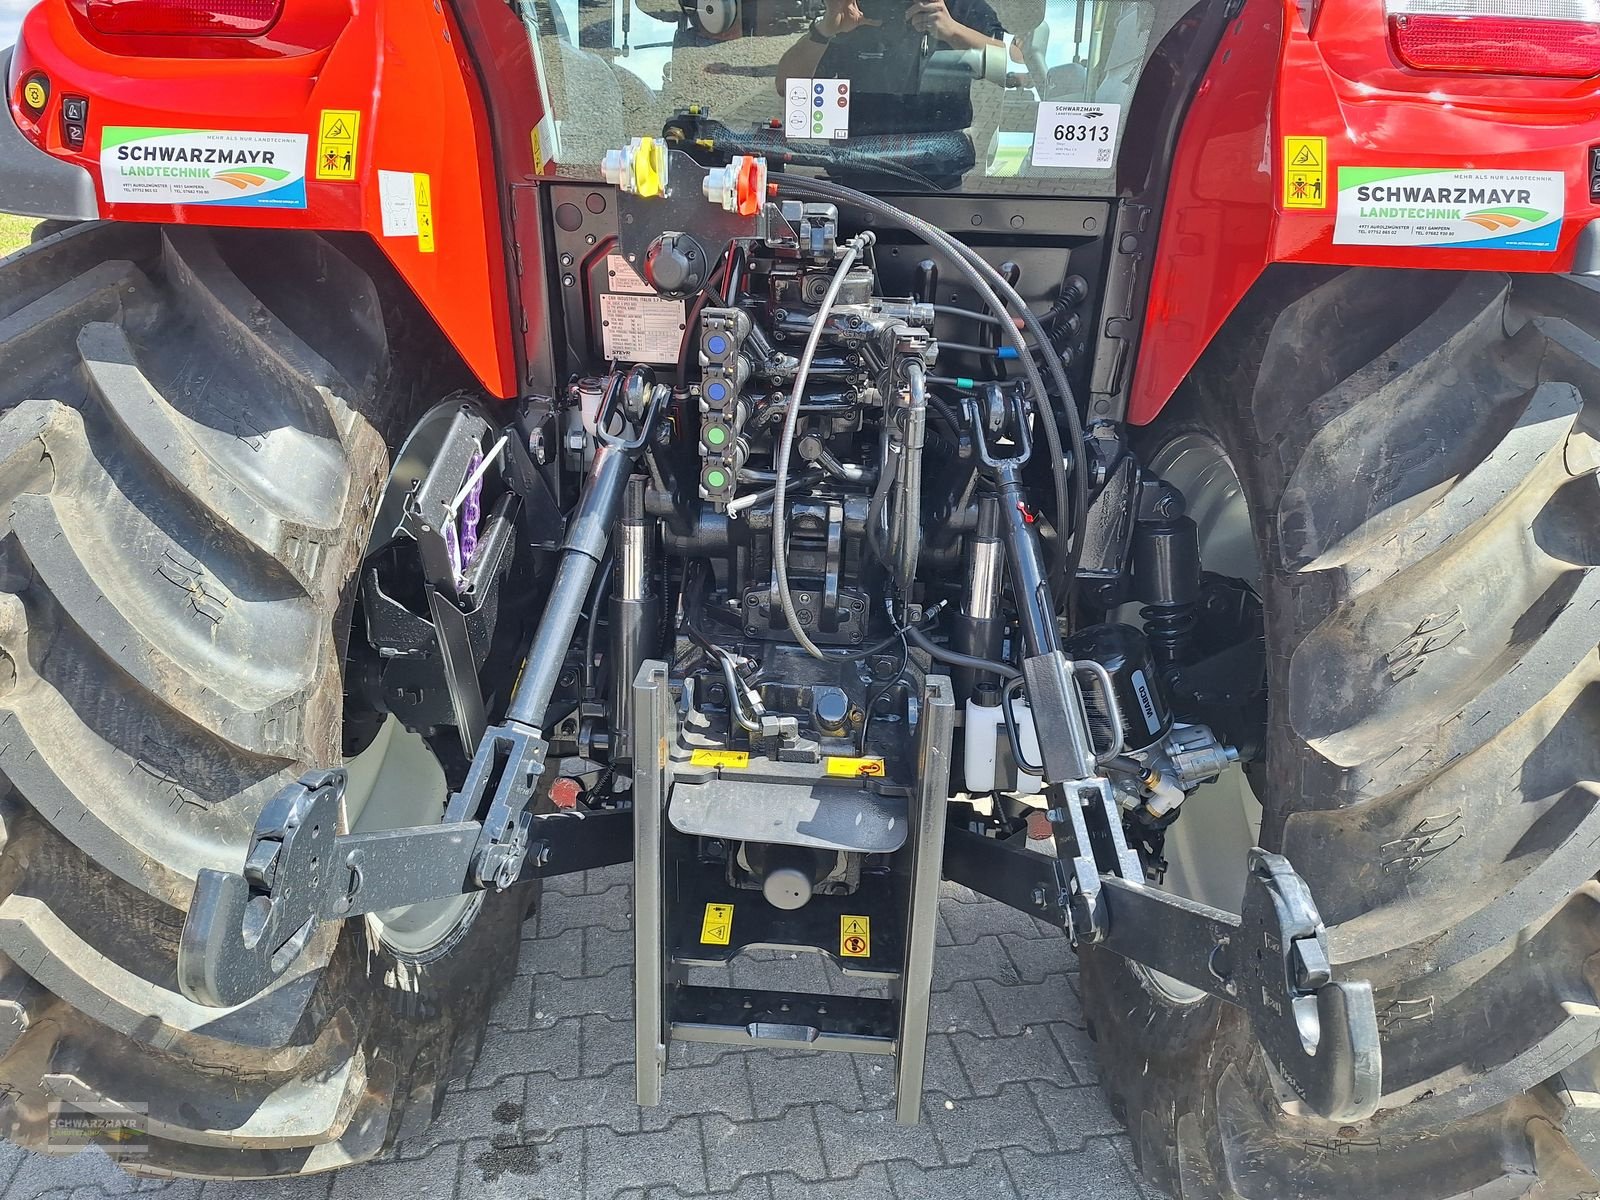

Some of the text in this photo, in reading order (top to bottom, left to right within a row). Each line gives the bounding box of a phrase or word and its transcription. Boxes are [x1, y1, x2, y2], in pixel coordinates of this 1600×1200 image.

[1054, 124, 1109, 142] 68313
[118, 146, 275, 164] SCHWARZMAYR
[120, 166, 210, 178] LANDTECHNIK
[1357, 186, 1531, 204] SCHWARZMAYR
[1360, 207, 1461, 220] LANDTECHNIK
[1139, 686, 1153, 718] WABCO
